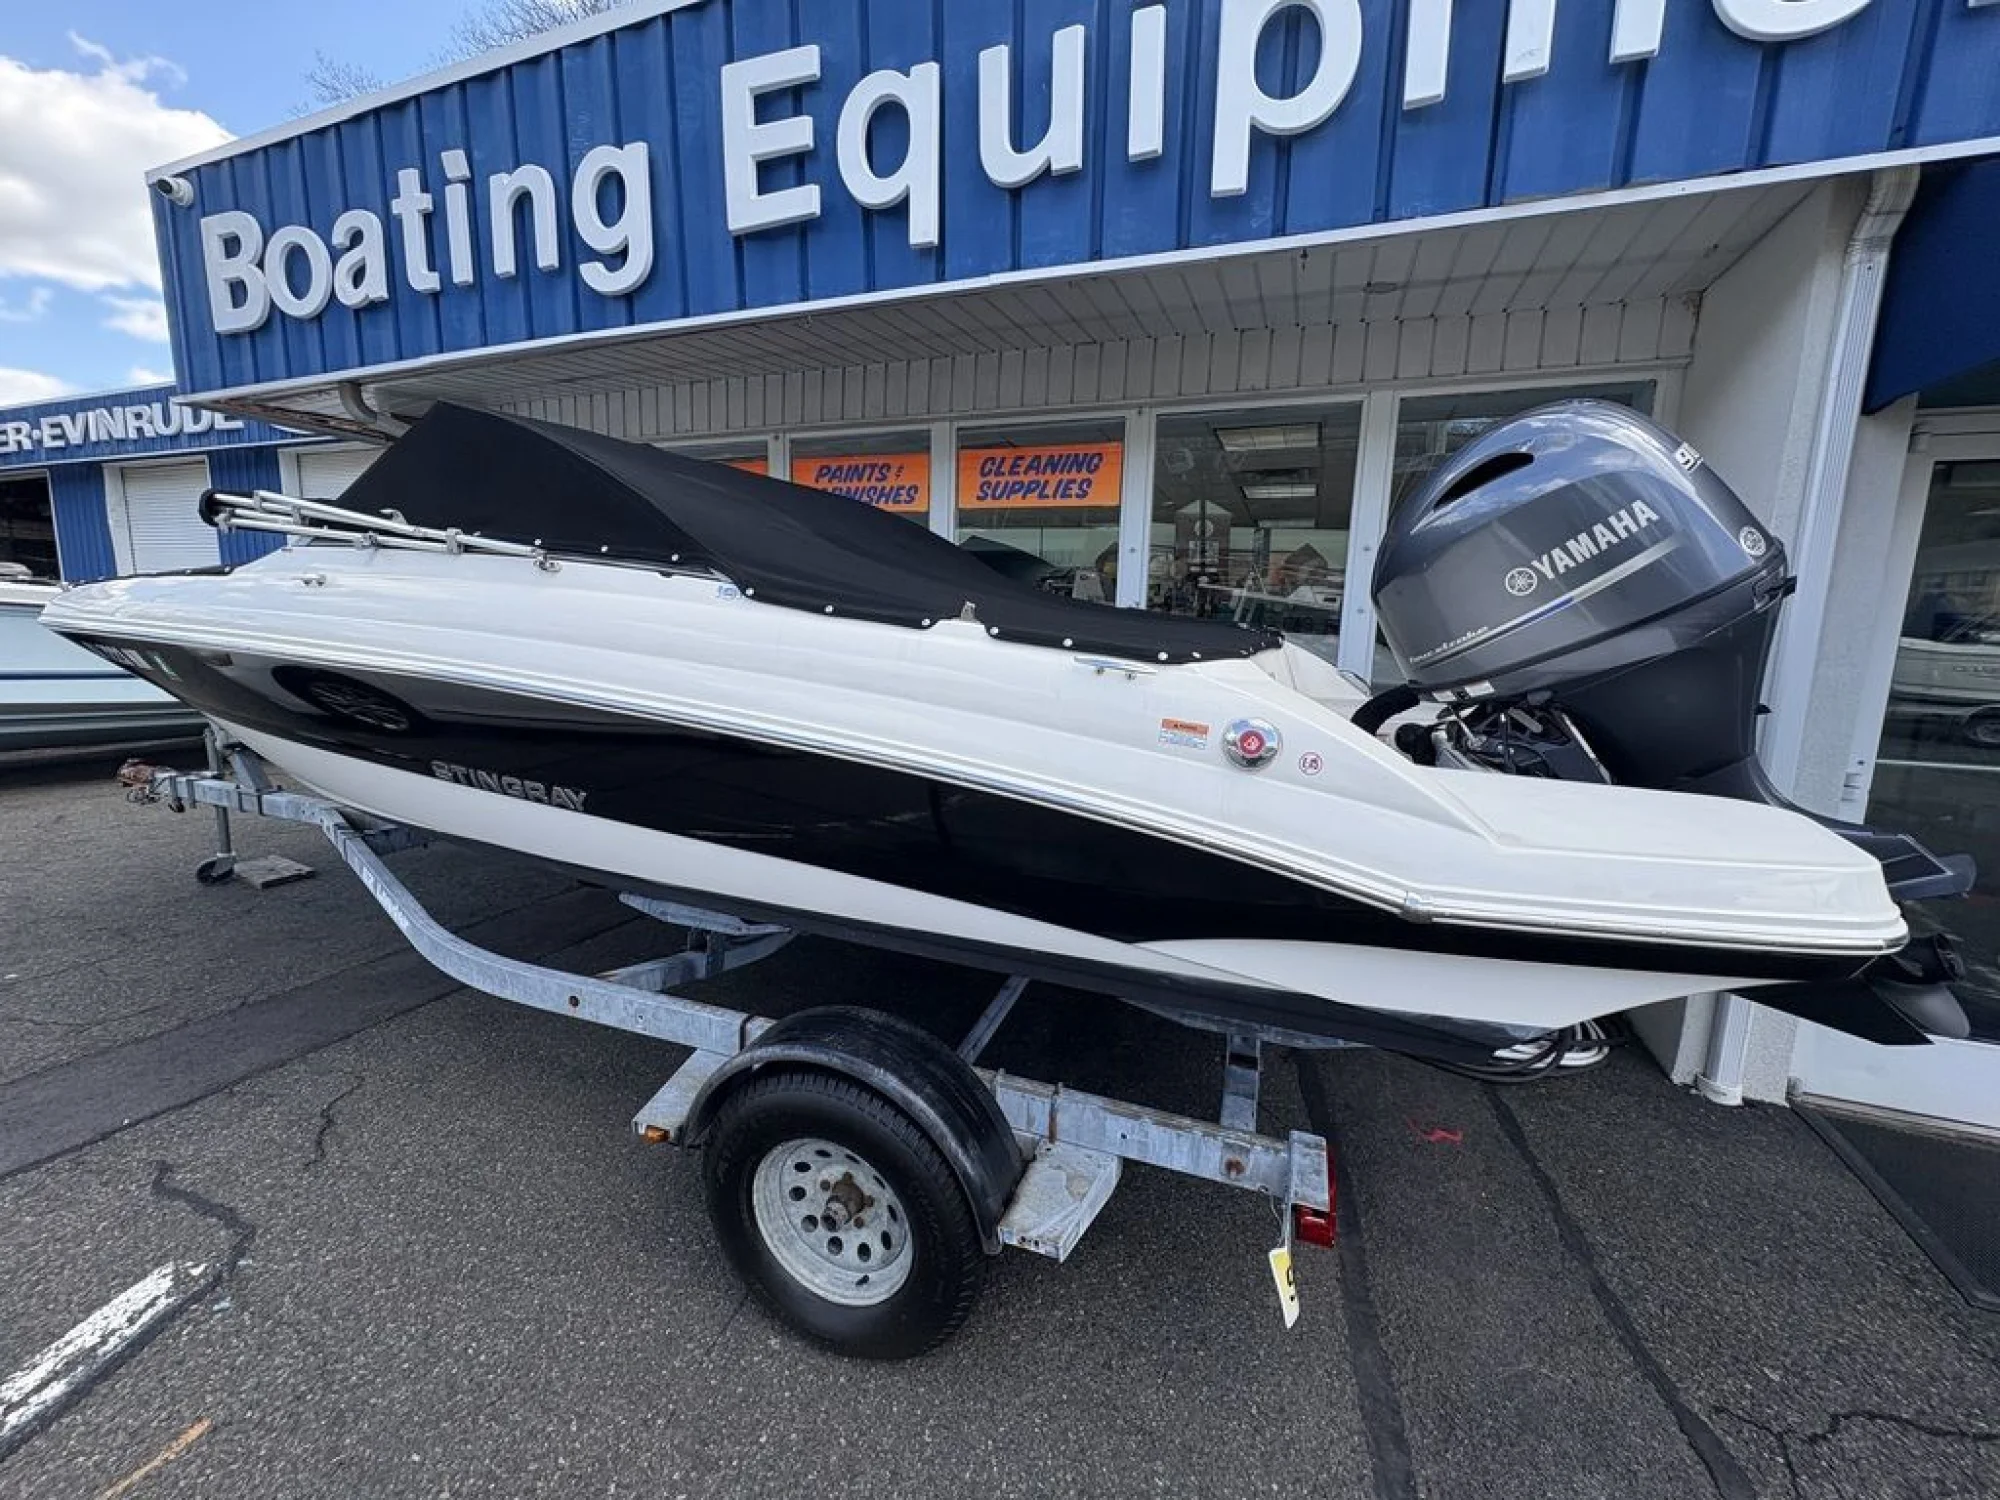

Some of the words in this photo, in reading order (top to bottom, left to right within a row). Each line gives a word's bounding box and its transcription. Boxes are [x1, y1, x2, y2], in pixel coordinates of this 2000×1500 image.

[201, 141, 654, 334] Boating
[814, 463, 891, 484] PAINTS
[980, 452, 1104, 478] CLEANING
[976, 478, 1092, 501] SUPPLIES
[1531, 499, 1660, 579] YAMAHA
[431, 759, 587, 812] STINGRAY
